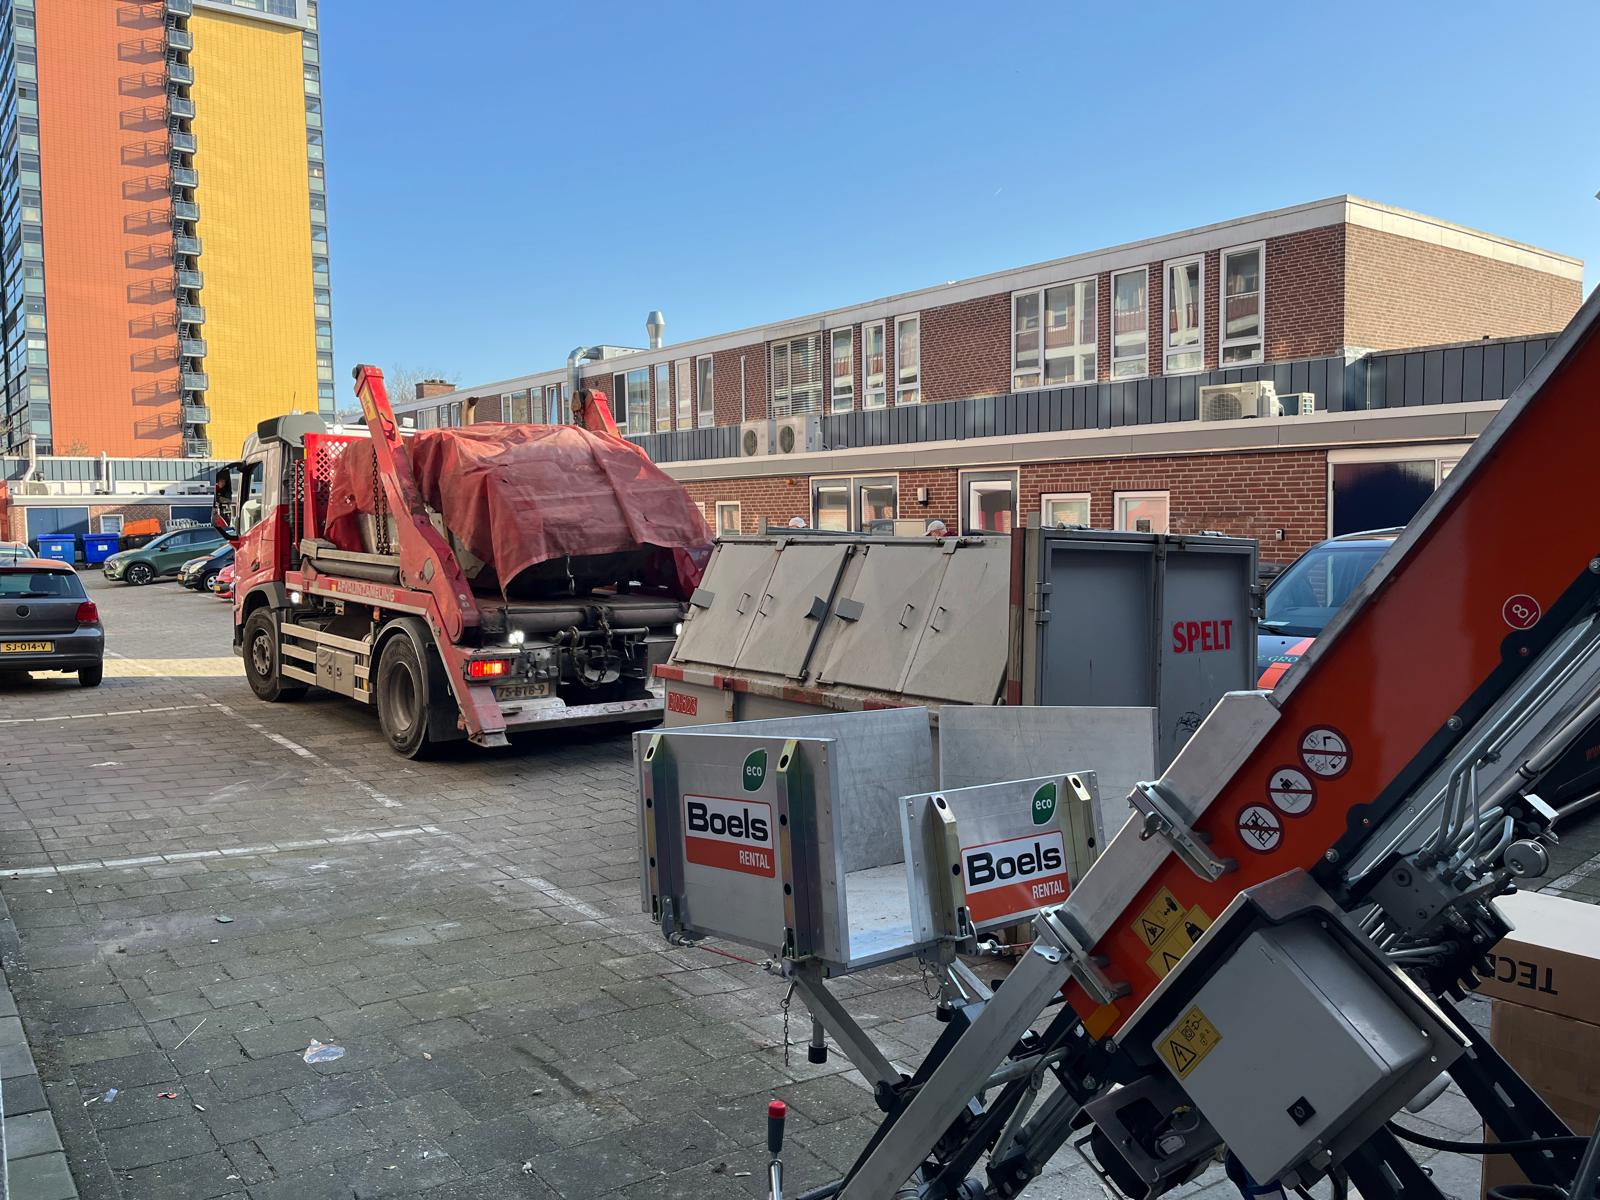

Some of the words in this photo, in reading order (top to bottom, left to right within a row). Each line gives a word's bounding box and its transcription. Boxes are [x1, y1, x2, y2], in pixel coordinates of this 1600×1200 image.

[1172, 620, 1233, 653] SPELT
[6, 643, 47, 651] SJ-014-V
[746, 765, 763, 777] eco
[1035, 798, 1052, 810] eco
[687, 801, 769, 842] Boels
[739, 850, 771, 869] RENTAL
[966, 841, 1062, 886] Boels
[1031, 879, 1065, 900] RENTAL
